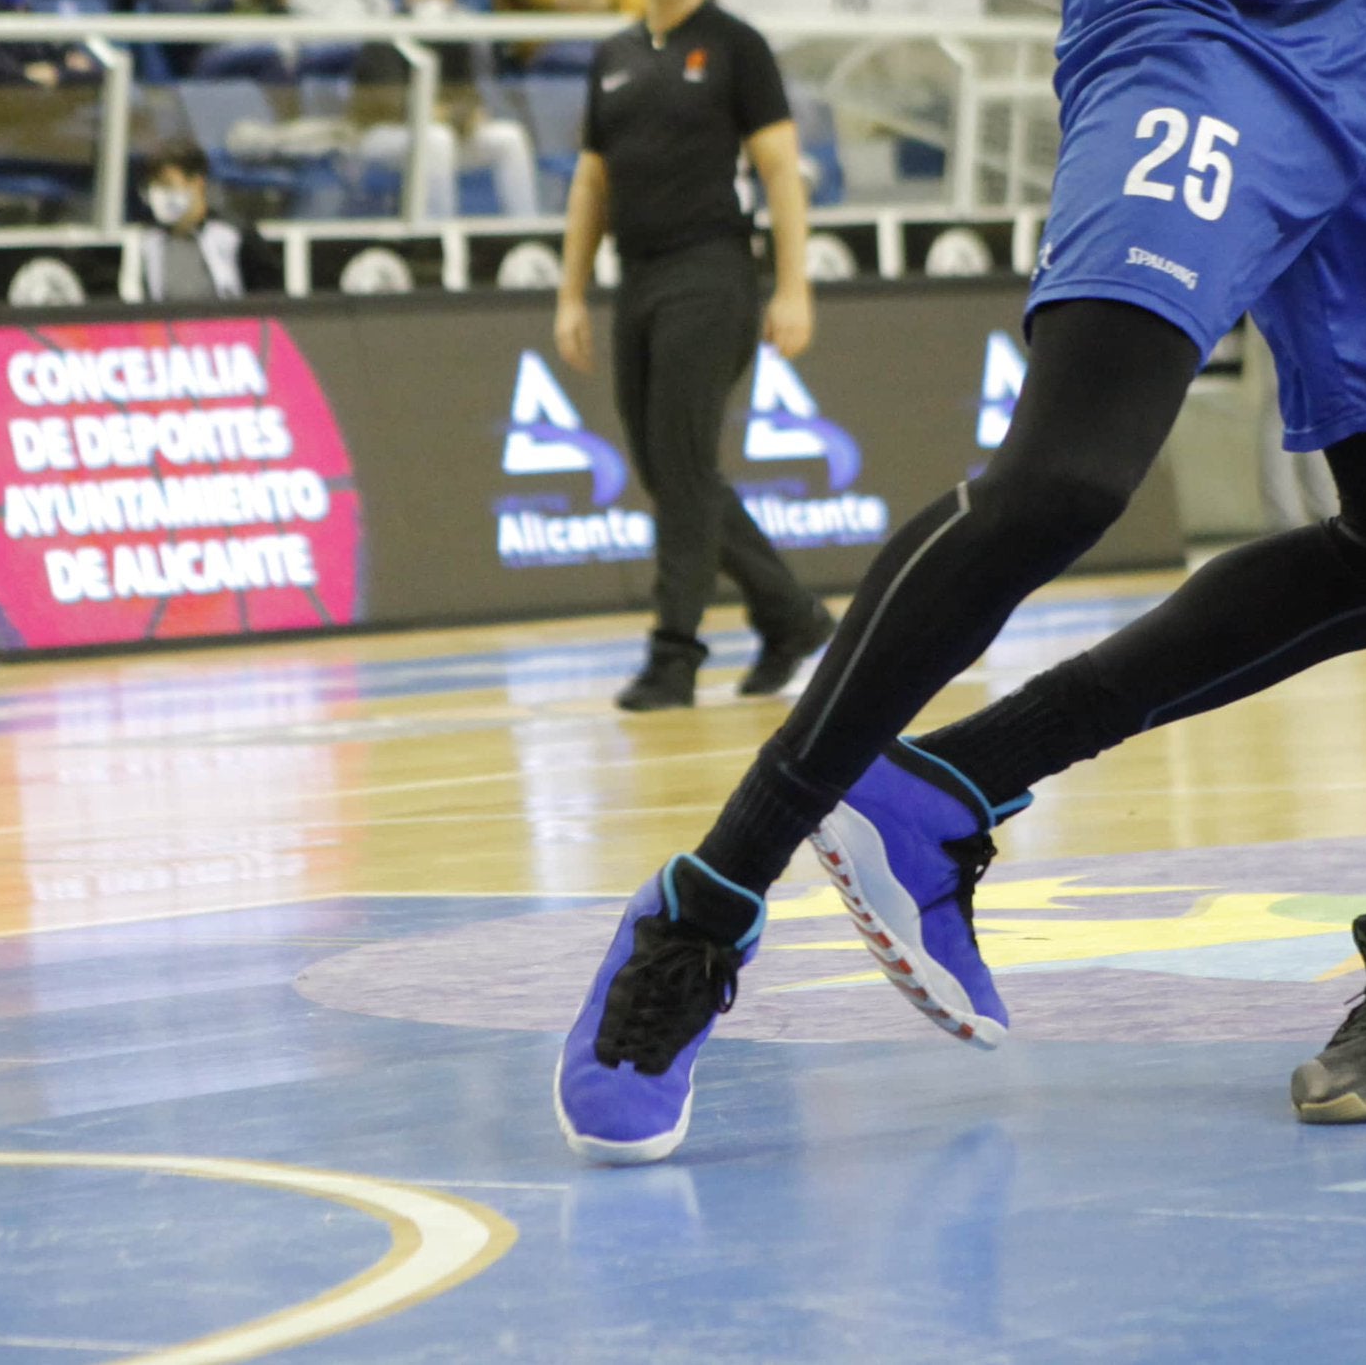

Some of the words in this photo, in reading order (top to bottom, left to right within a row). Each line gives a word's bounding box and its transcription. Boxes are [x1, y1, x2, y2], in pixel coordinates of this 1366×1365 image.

[1122, 107, 1240, 221] 25
[1125, 246, 1199, 290] SPALDING
[7, 343, 268, 406] CONCEJALIA
[8, 417, 77, 472] DE
[72, 407, 294, 469] DEPORTES
[4, 468, 330, 540] AYUNTAMIENTO
[497, 509, 656, 554] Alicante
[44, 547, 113, 603] DE
[112, 534, 319, 598] ALICANTE
